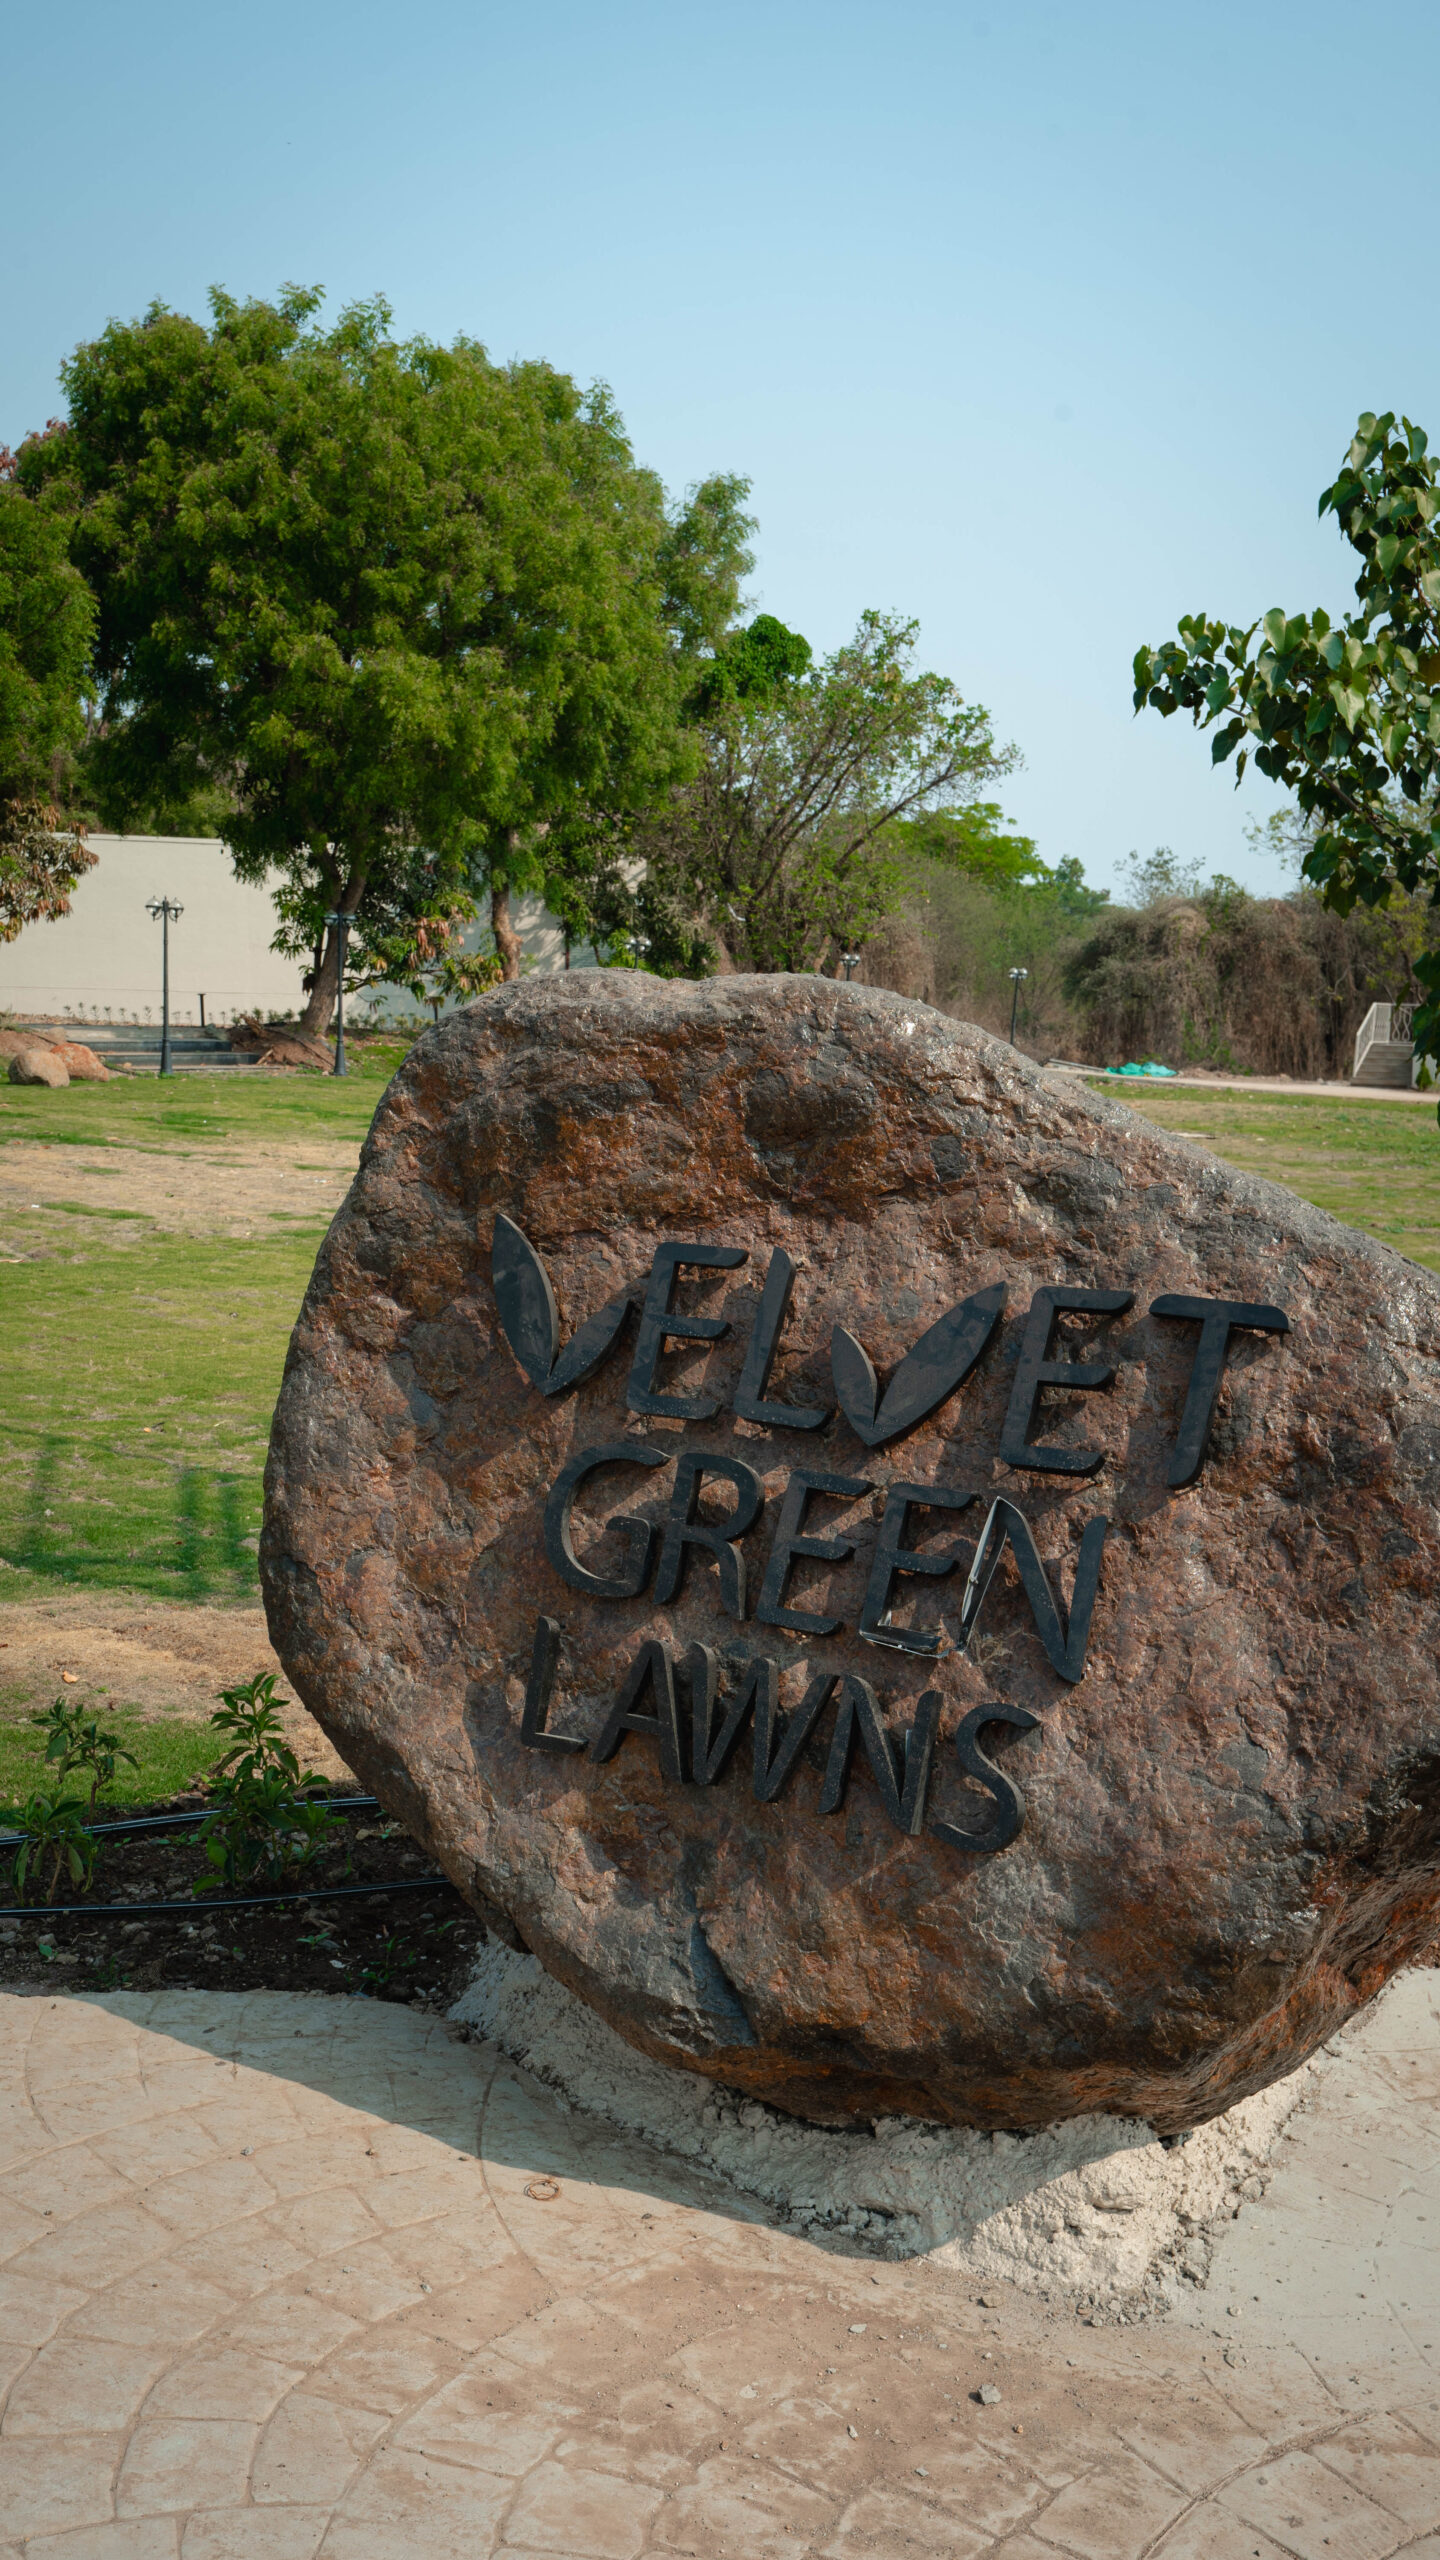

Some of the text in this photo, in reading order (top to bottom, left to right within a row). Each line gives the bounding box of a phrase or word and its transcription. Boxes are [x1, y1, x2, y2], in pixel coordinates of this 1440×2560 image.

[492, 1213, 1291, 1490] VELVET
[543, 1443, 1108, 1685] GREEN
[520, 1616, 1040, 1853] LAWNS
